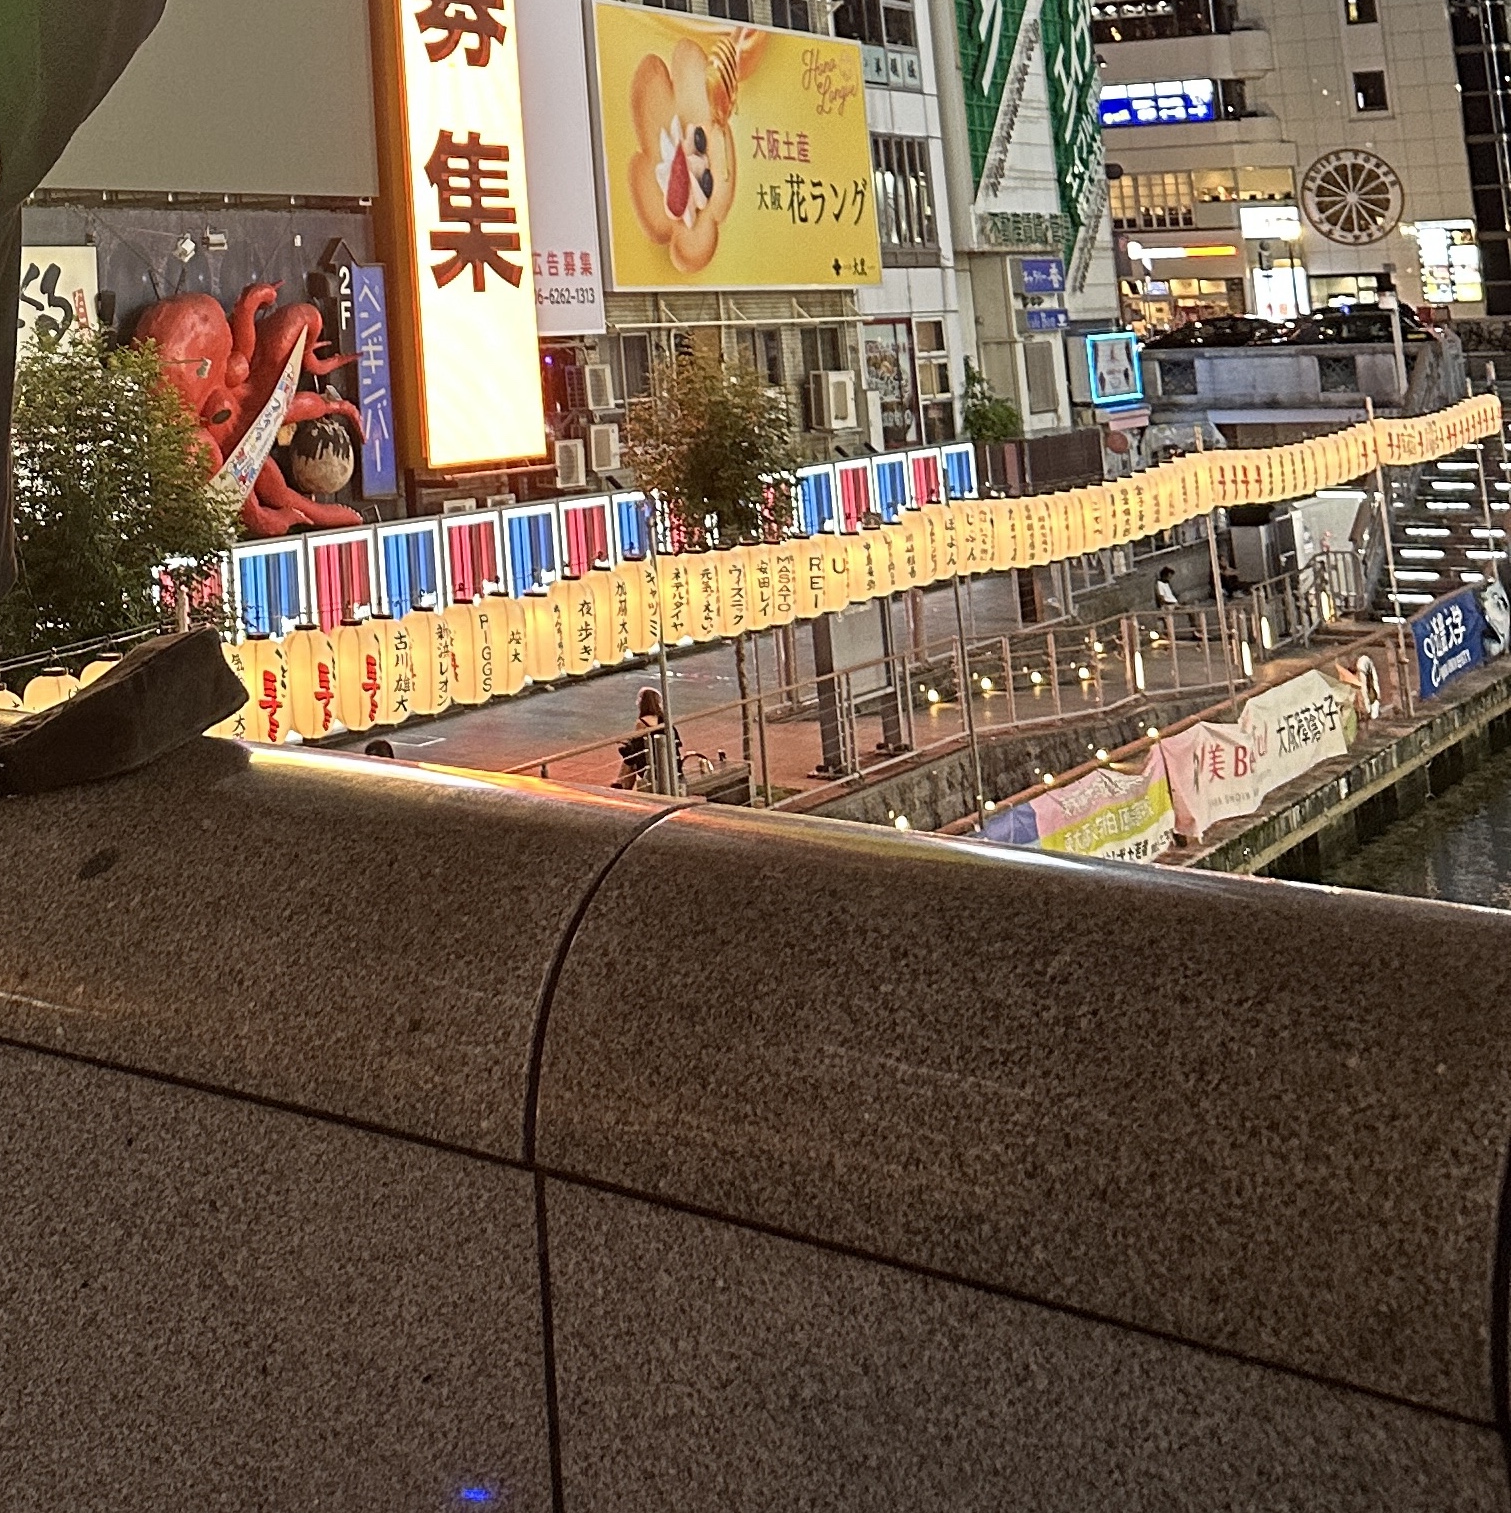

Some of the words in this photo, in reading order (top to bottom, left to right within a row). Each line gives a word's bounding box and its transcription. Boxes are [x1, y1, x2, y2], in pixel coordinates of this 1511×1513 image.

[752, 127, 810, 164] 大阪土産
[339, 265, 352, 331] 2F
[534, 287, 595, 306] 6-6262-1313
[756, 559, 771, 617] 安田レイ
[776, 555, 792, 612] MASATO
[809, 556, 825, 608] REI
[392, 630, 411, 713] 古川雄大
[478, 613, 493, 693] PIGGS
[1208, 741, 1226, 784] 美
